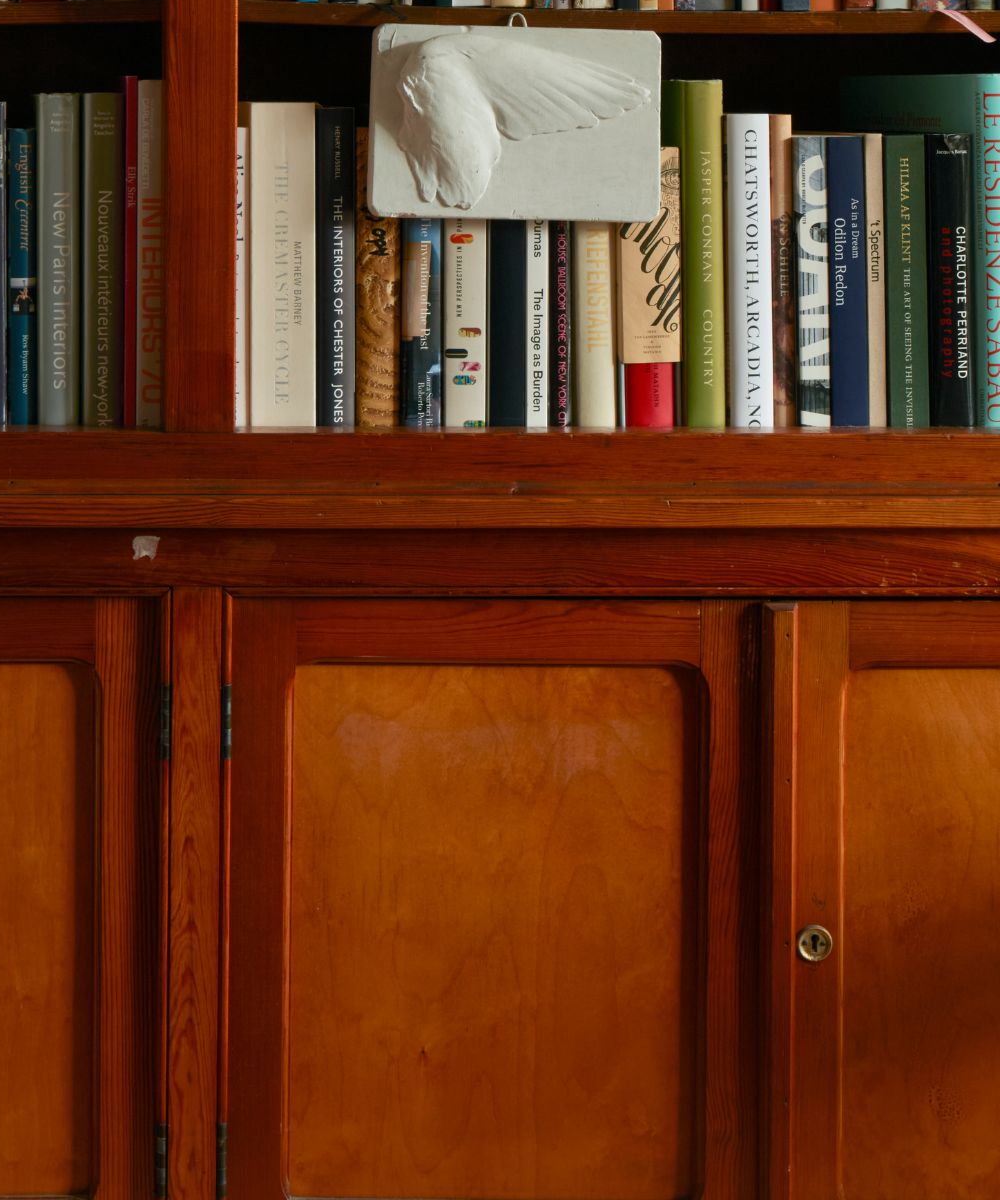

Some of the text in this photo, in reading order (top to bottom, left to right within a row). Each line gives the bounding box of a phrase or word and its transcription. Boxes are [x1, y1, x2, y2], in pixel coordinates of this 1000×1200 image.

[833, 218, 848, 306] Odilon Redon
[900, 157, 911, 263] HILMA AF KLINT
[53, 191, 70, 390] New Paris Interiors
[333, 196, 343, 423] THE INTERIORS OF CHESTER JONES
[530, 289, 544, 412] The Image as Burden
[956, 226, 968, 379] CHARLOTTE PERRIAND
